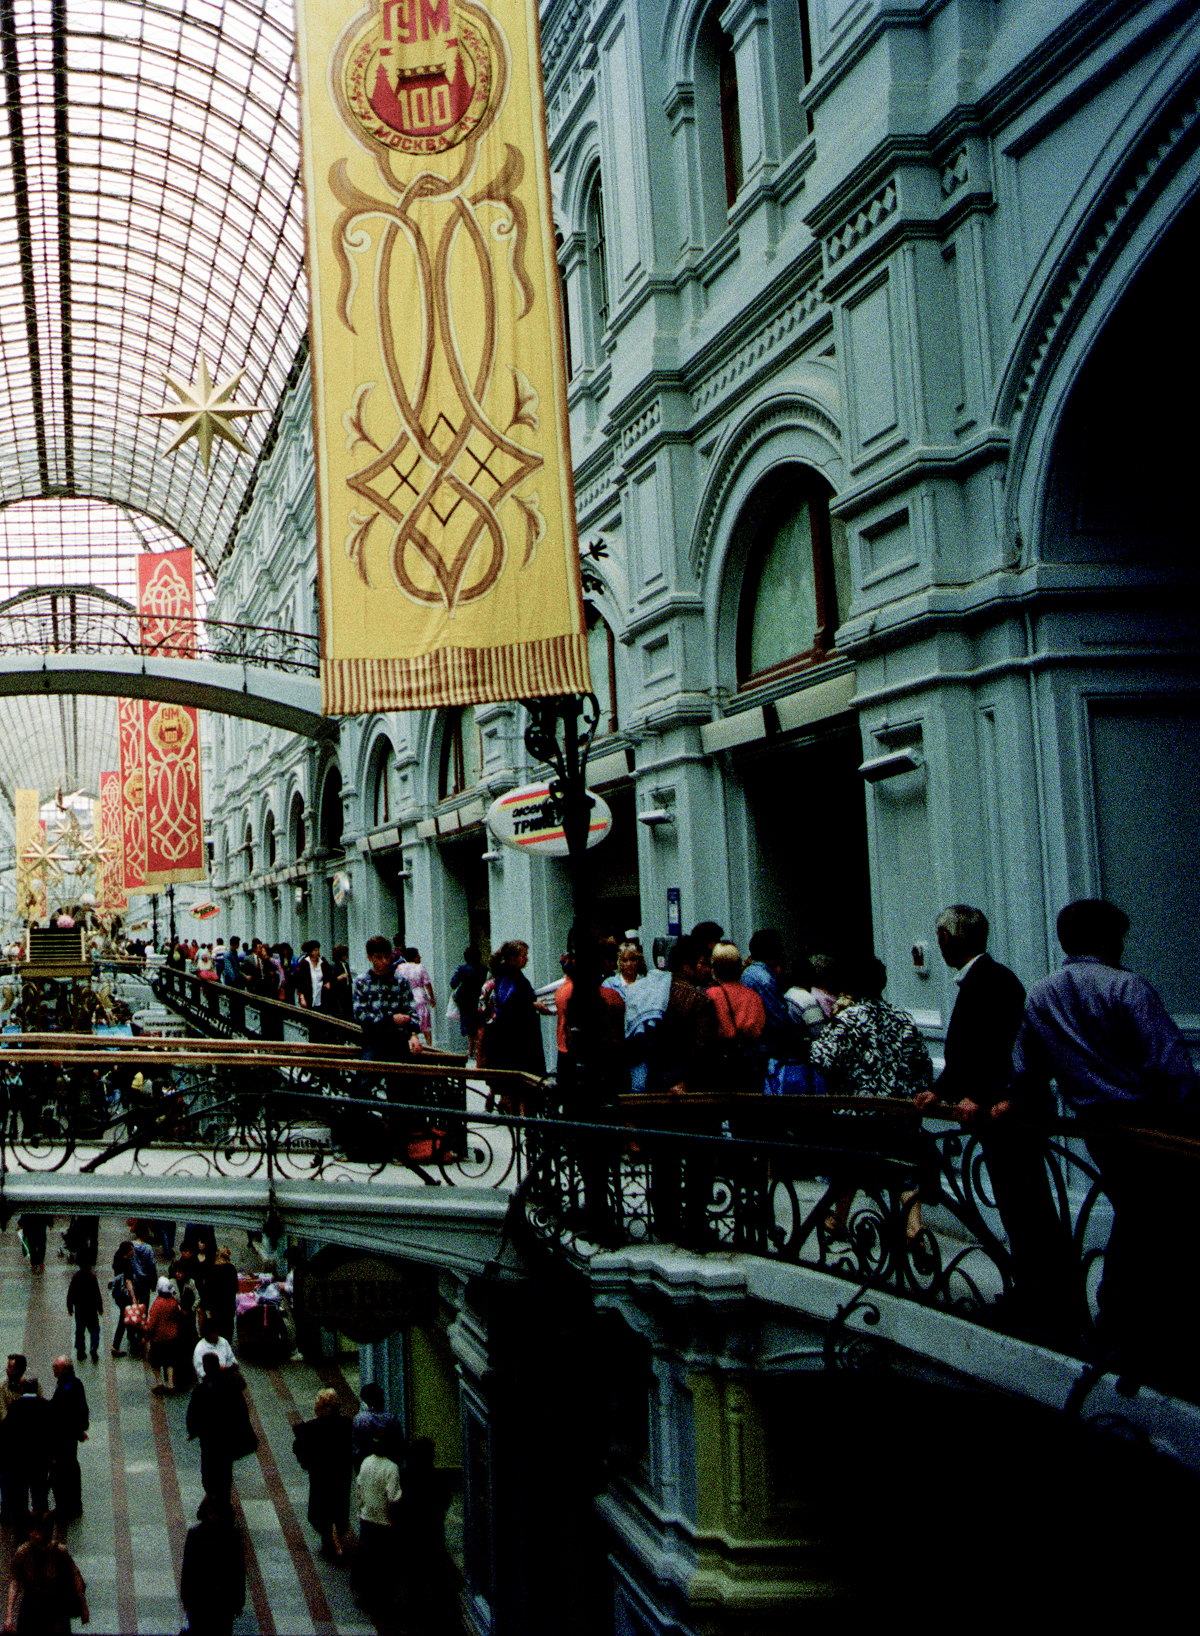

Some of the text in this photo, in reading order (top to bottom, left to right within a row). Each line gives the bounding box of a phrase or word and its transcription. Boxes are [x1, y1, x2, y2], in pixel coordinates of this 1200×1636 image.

[383, 0, 450, 44] ГУМ
[398, 84, 451, 130] 100
[374, 125, 453, 151] МОСКВА
[162, 706, 179, 720] ГУМ
